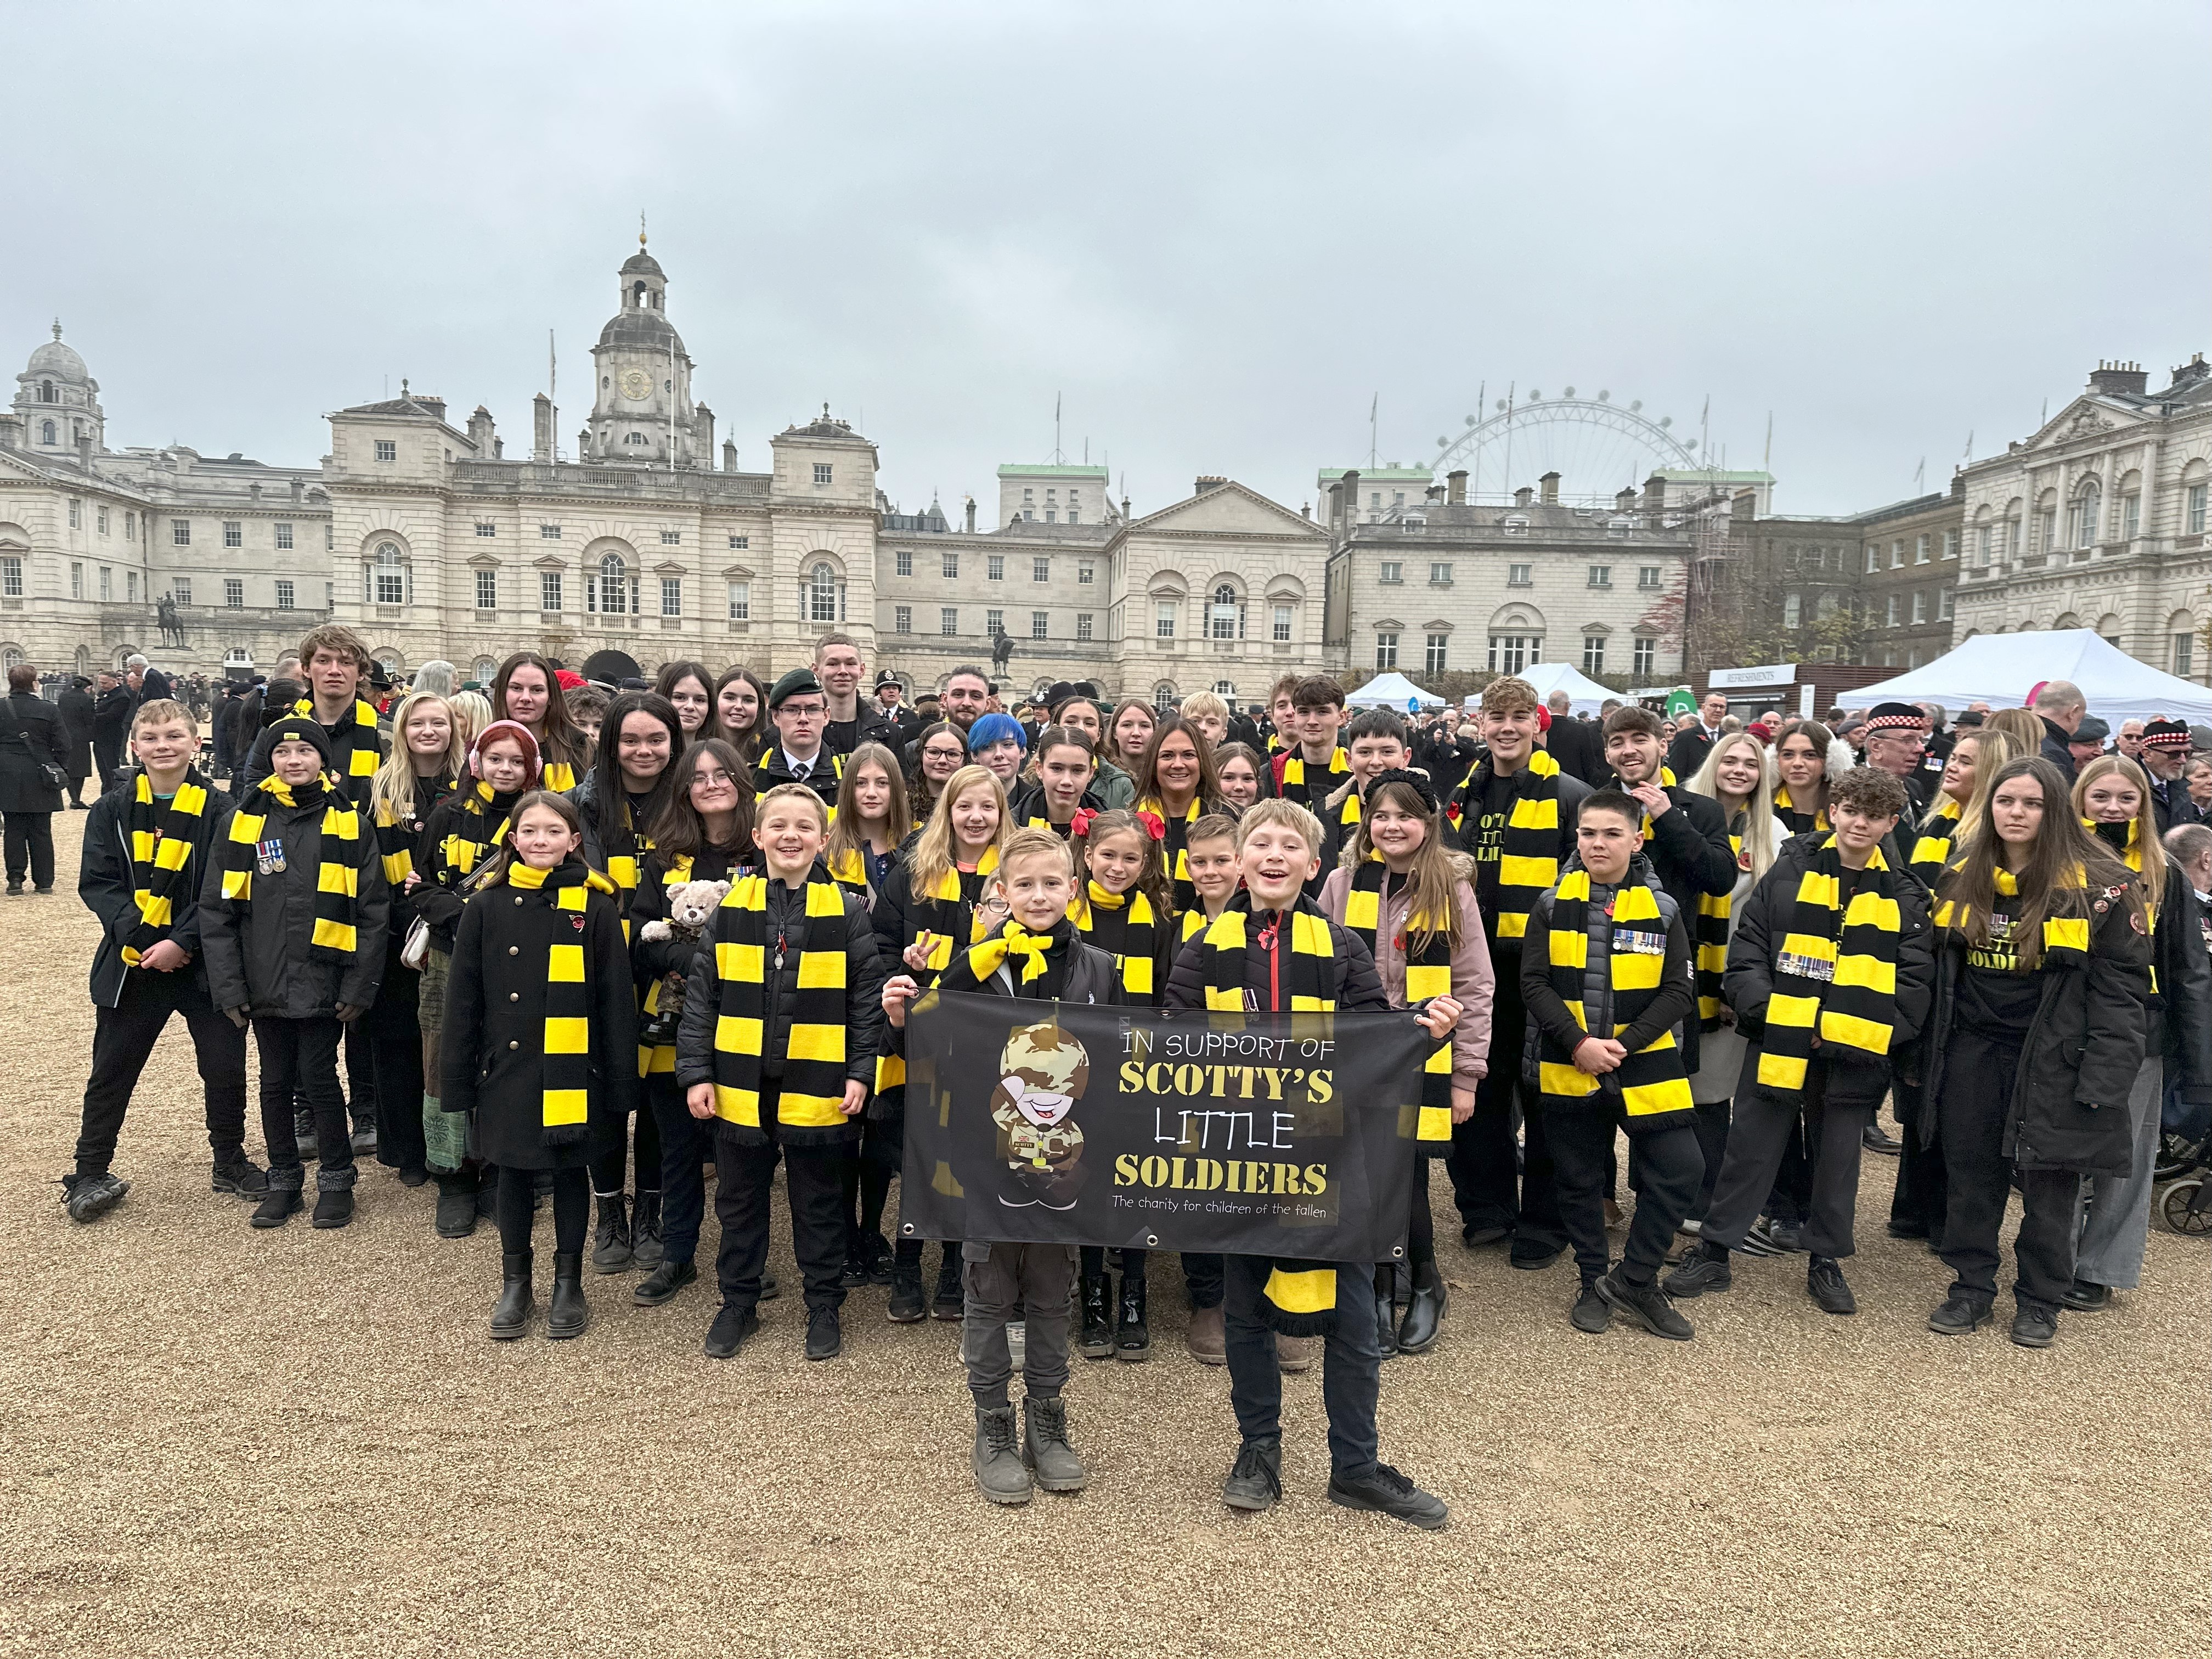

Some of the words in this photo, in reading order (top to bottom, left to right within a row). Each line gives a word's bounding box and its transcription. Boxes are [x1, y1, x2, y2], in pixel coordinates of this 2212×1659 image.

[1727, 671, 1775, 683] REFRESHMENTS
[1122, 1030, 1153, 1054] IN
[1165, 1032, 1295, 1061] SUPPORT
[1300, 1038, 1335, 1061] OF
[1119, 1060, 1333, 1104] SCOTTY'S
[1154, 1107, 1295, 1150] LITTLE
[1114, 1154, 1327, 1195] SOLDIERS
[1111, 1194, 1134, 1207] The
[1138, 1196, 1179, 1213] charity
[1183, 1199, 1201, 1211] for
[1205, 1200, 1251, 1215] children
[1255, 1204, 1268, 1214] of
[1272, 1203, 1291, 1215] the
[1295, 1203, 1327, 1218] fallen
